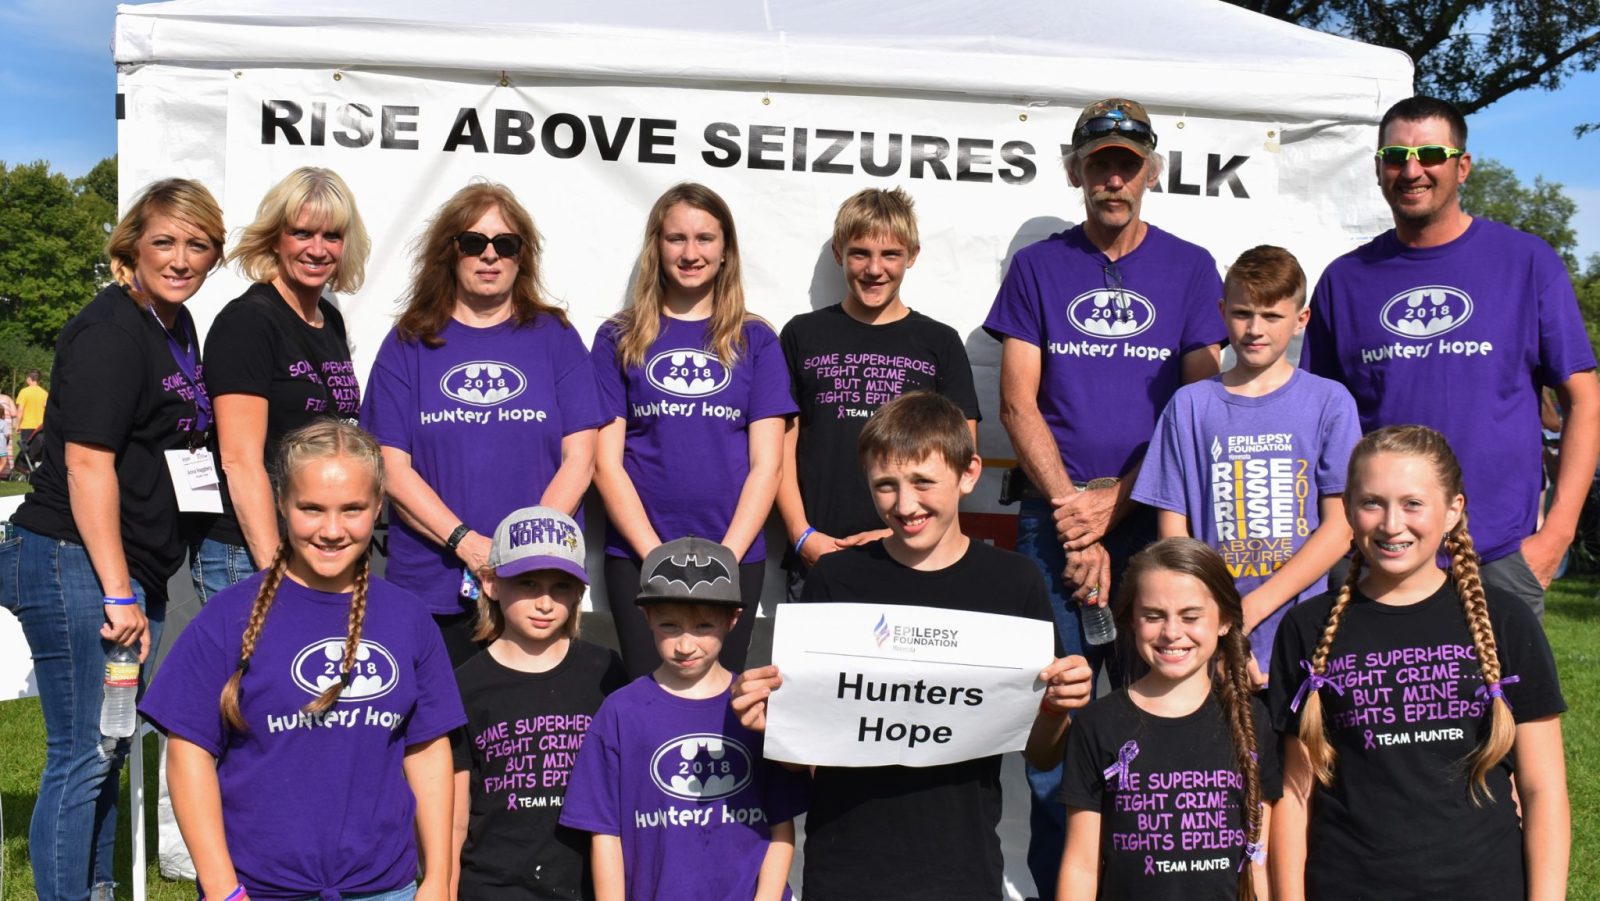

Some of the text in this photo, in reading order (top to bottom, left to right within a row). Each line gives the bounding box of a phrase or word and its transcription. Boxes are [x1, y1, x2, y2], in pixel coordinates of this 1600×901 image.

[261, 99, 1250, 199] RISE ABOVE SEIZURES LK
[1091, 308, 1134, 320] 2018
[1405, 305, 1450, 319] 2018
[669, 366, 712, 378] 2018
[804, 353, 936, 376] SOME SUPERHEROES
[816, 365, 858, 379] FIGHT
[463, 378, 506, 388] 2018
[834, 378, 903, 394] BUT MINE
[845, 408, 868, 418] TEAM
[1228, 433, 1293, 446] EPILEPSY
[1228, 443, 1293, 454] FOUNDATION
[1211, 458, 1293, 483] RISE
[1212, 478, 1293, 503] RISE
[1295, 459, 1309, 537] 2018
[1213, 498, 1294, 522] RISE
[509, 517, 555, 534] DEFEND
[1216, 518, 1293, 542] RISE
[509, 527, 567, 550] NORTH
[1220, 538, 1293, 552] ABOVE
[1221, 550, 1293, 564] EIZURES
[893, 636, 958, 648] FOUNDATION
[894, 625, 958, 640] EPILEPSY
[1323, 644, 1477, 678] ME SUPERHERO
[837, 671, 984, 706] Hunters
[1353, 681, 1458, 706] BUT MINE
[514, 714, 593, 735] SUPERHER
[1335, 706, 1396, 730] FIGHTS
[858, 716, 953, 748] Hope
[1376, 728, 1464, 746] TEAM HUNTER
[485, 736, 533, 763] FIGHT
[505, 752, 576, 773] BUT MIN
[678, 760, 730, 775] 2018
[1148, 769, 1243, 790] SUPERHERO
[518, 796, 547, 808] TEAM
[1115, 792, 1168, 812] FIGHT
[1137, 810, 1228, 831] BUT MINE
[1113, 832, 1175, 851] FIGHTS
[1156, 857, 1230, 873] TEAM HUNTER
